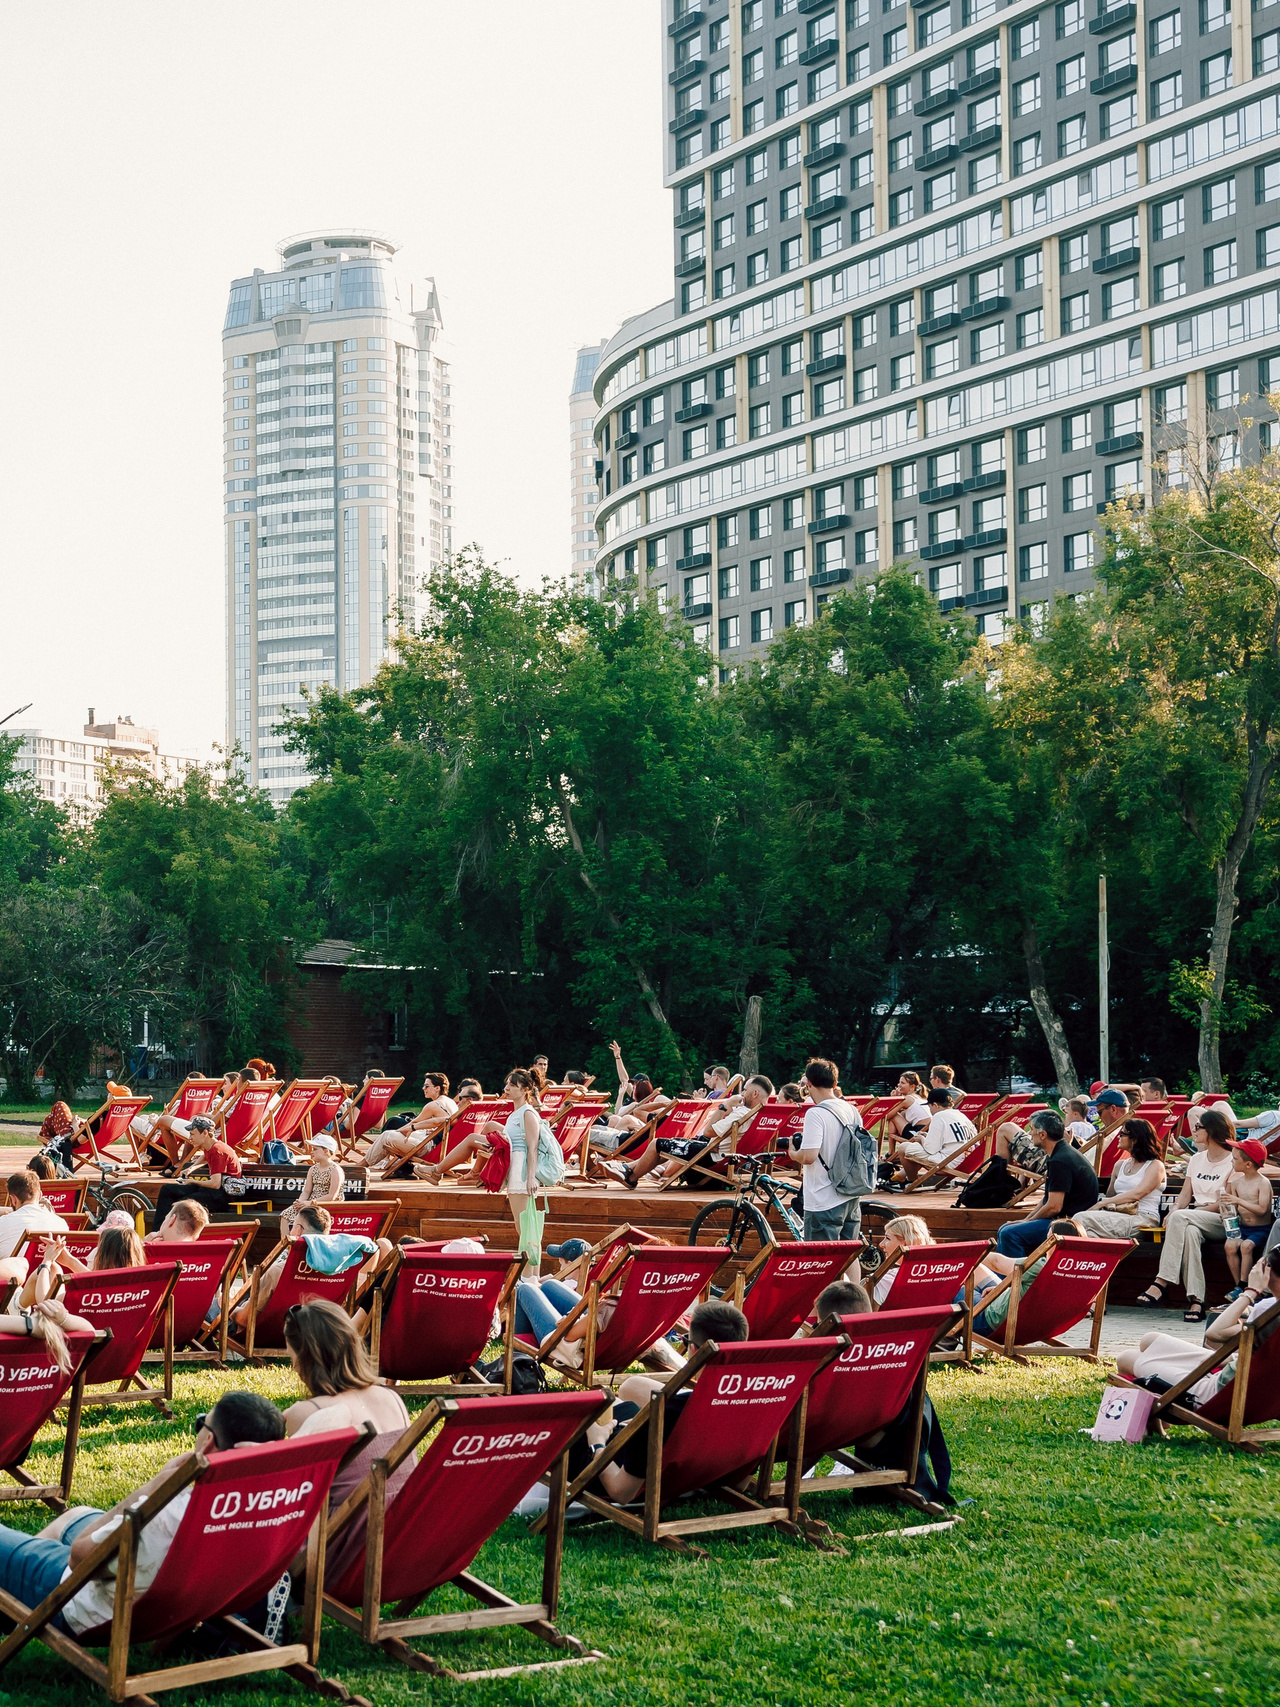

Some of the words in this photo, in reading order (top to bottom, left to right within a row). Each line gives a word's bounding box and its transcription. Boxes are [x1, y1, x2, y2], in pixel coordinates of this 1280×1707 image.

[337, 1216, 373, 1226] УБРиР
[181, 1262, 212, 1274] БРиР
[795, 1259, 833, 1270] УБРиР
[928, 1262, 965, 1275] УБРиР
[1073, 1260, 1107, 1272] УБРиР
[439, 1276, 487, 1290] УБРиР
[663, 1271, 701, 1286] УБРиР
[105, 1289, 150, 1305] УБРиР
[412, 1287, 429, 1295] Банк
[429, 1289, 447, 1297] моих
[447, 1292, 484, 1300] интересов
[78, 1307, 95, 1315] Банк
[95, 1306, 113, 1314] моих
[113, 1303, 147, 1312] интересов
[864, 1340, 916, 1359] УБРиР
[8, 1364, 60, 1381] УБРиР
[833, 1365, 851, 1373] Банк
[851, 1364, 870, 1372] моих
[870, 1361, 908, 1371] интересов
[16, 1383, 54, 1393] интересов
[743, 1374, 796, 1392] УБРиР
[711, 1397, 730, 1406] Банк
[748, 1395, 787, 1404] интересов
[485, 1430, 552, 1451] УБРиР
[442, 1457, 466, 1467] Банк
[466, 1456, 489, 1466] моих
[489, 1451, 538, 1463] интересов
[244, 1481, 314, 1512] УБРиР
[203, 1522, 228, 1534] Банк
[228, 1519, 255, 1531] моих
[255, 1509, 306, 1529] интересов
